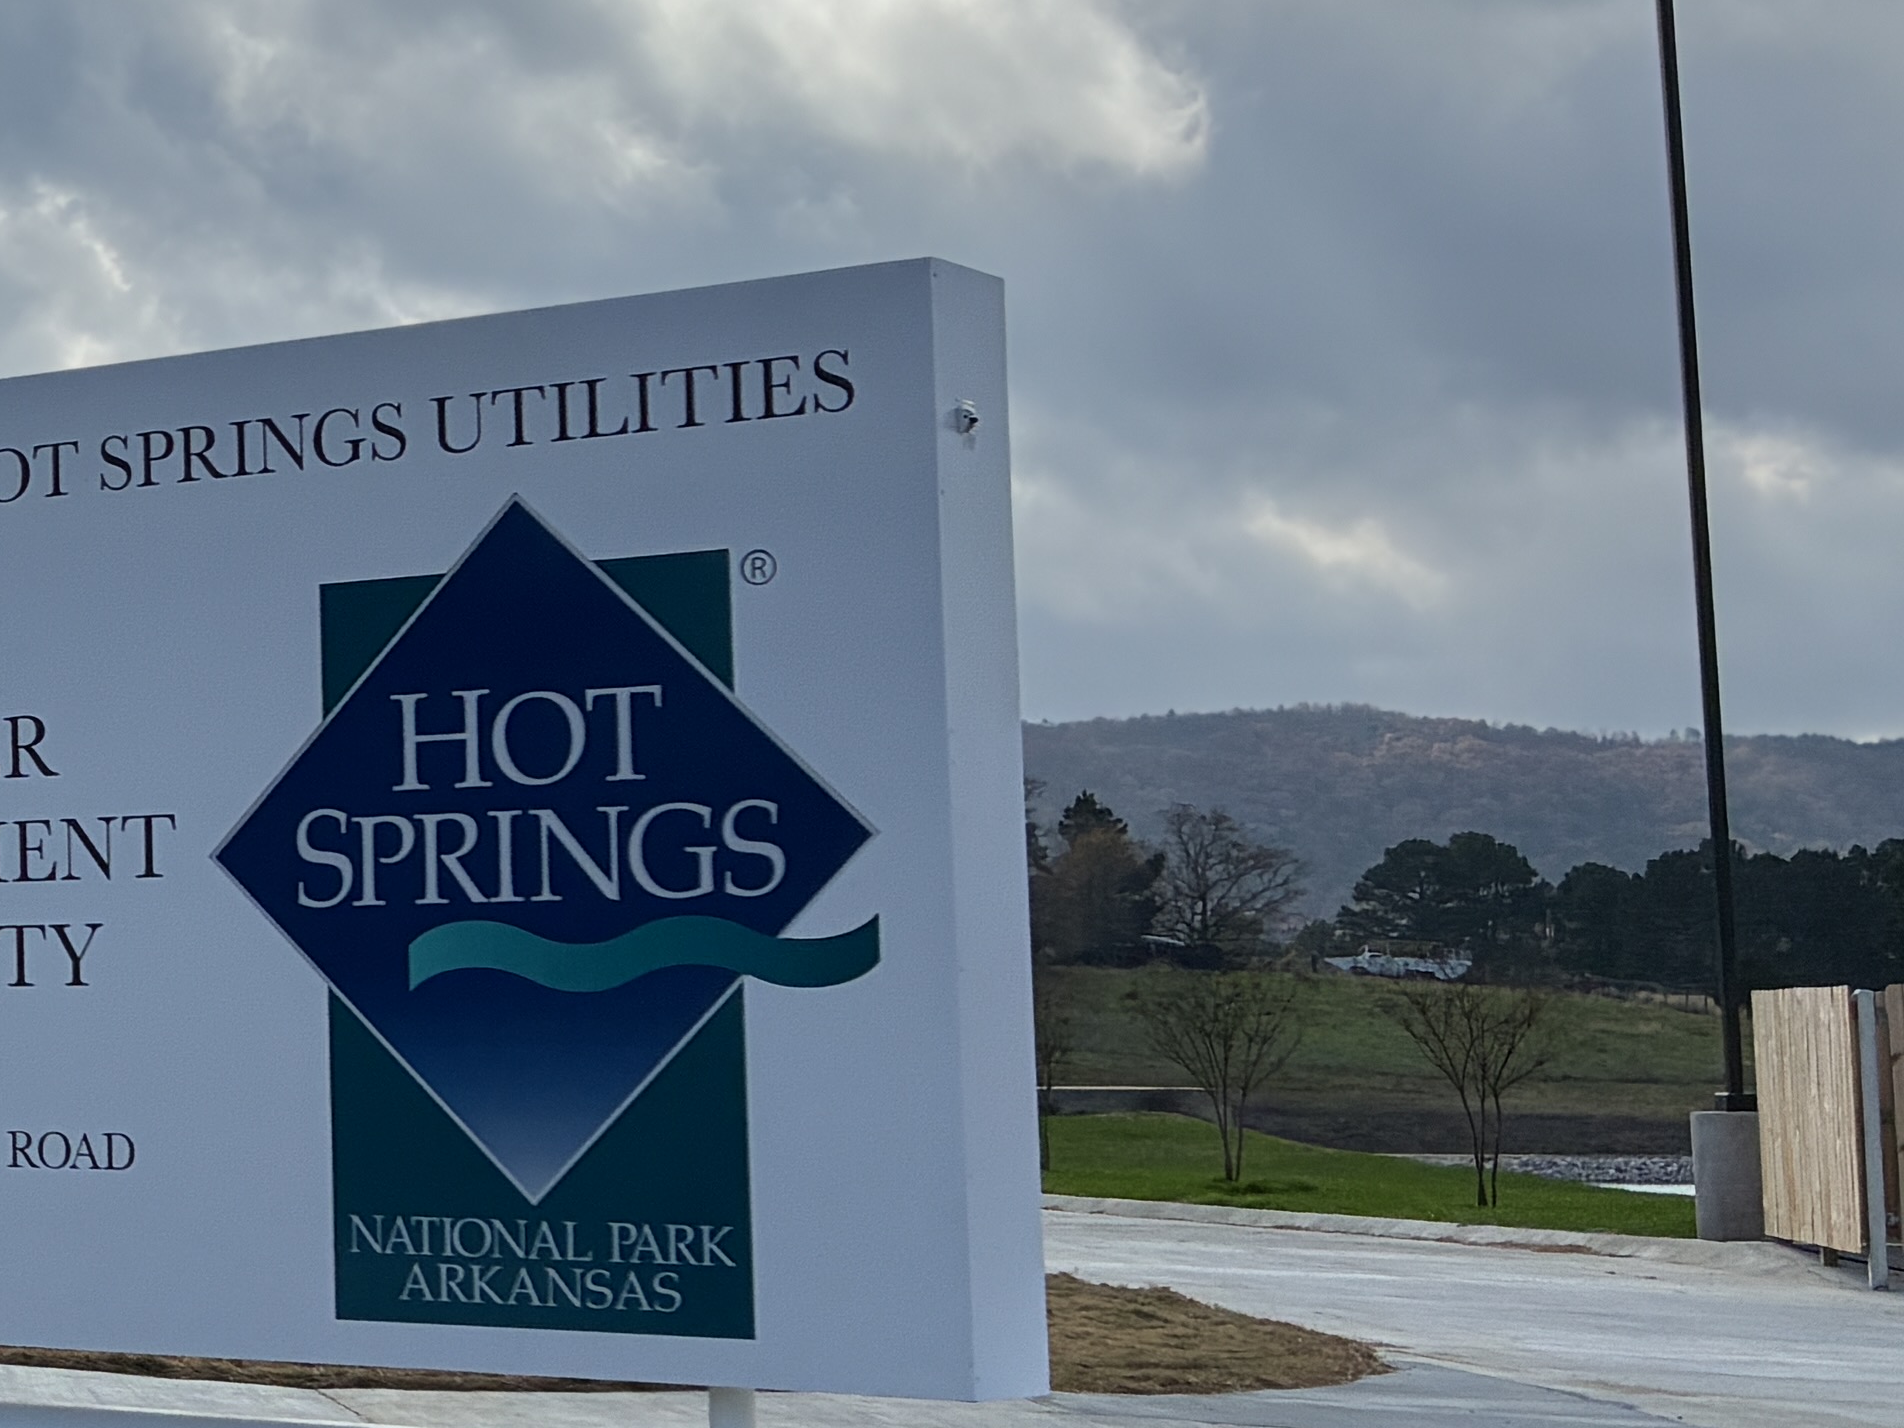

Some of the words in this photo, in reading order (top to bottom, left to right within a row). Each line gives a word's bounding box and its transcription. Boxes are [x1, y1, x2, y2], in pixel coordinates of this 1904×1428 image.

[101, 403, 406, 490] SPRINGS
[430, 350, 854, 453] UTILITIES
[390, 685, 662, 791] HOT
[297, 799, 786, 908] SPRINGS
[7, 1131, 134, 1170] ROAD
[348, 1214, 593, 1262] NATIONAL
[607, 1222, 737, 1266] PARK
[398, 1262, 682, 1313] ARKANSAS
